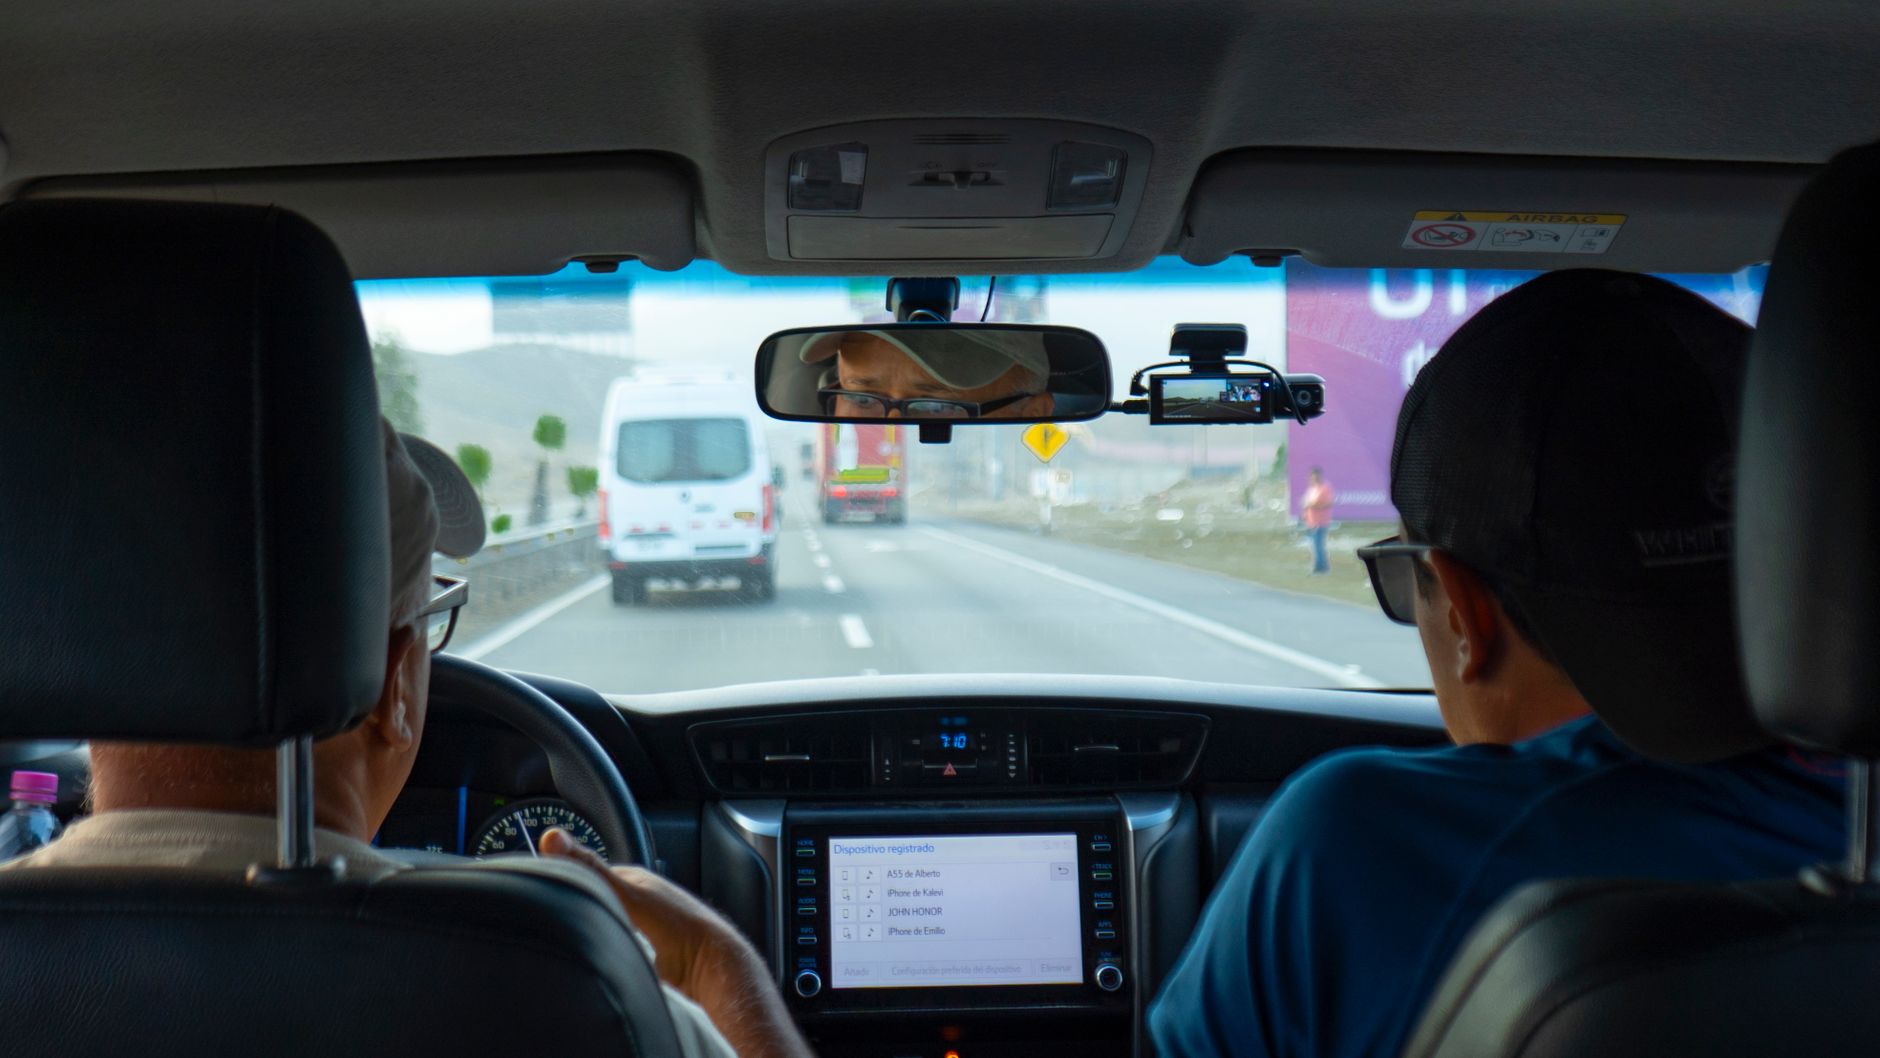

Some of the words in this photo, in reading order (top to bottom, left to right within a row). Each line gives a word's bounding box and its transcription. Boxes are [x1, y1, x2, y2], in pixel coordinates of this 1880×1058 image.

[1505, 214, 1599, 223] AIRBAG
[940, 731, 968, 748] 7:10
[523, 818, 538, 827] 100
[542, 817, 557, 825] 120
[504, 827, 517, 836] 80
[492, 841, 505, 849] 60
[834, 844, 885, 856] Dispositivo
[887, 843, 935, 855] registrado
[887, 870, 903, 878] A55
[904, 870, 913, 878] de
[915, 869, 941, 878] Alberto
[887, 889, 911, 897] iPhone
[912, 889, 921, 897] de
[923, 888, 944, 897] Kalevi
[888, 907, 910, 916] JOHN
[912, 907, 943, 916] HONOR
[888, 927, 912, 936] iPhone
[913, 927, 922, 935] de
[924, 926, 946, 935] Emilio
